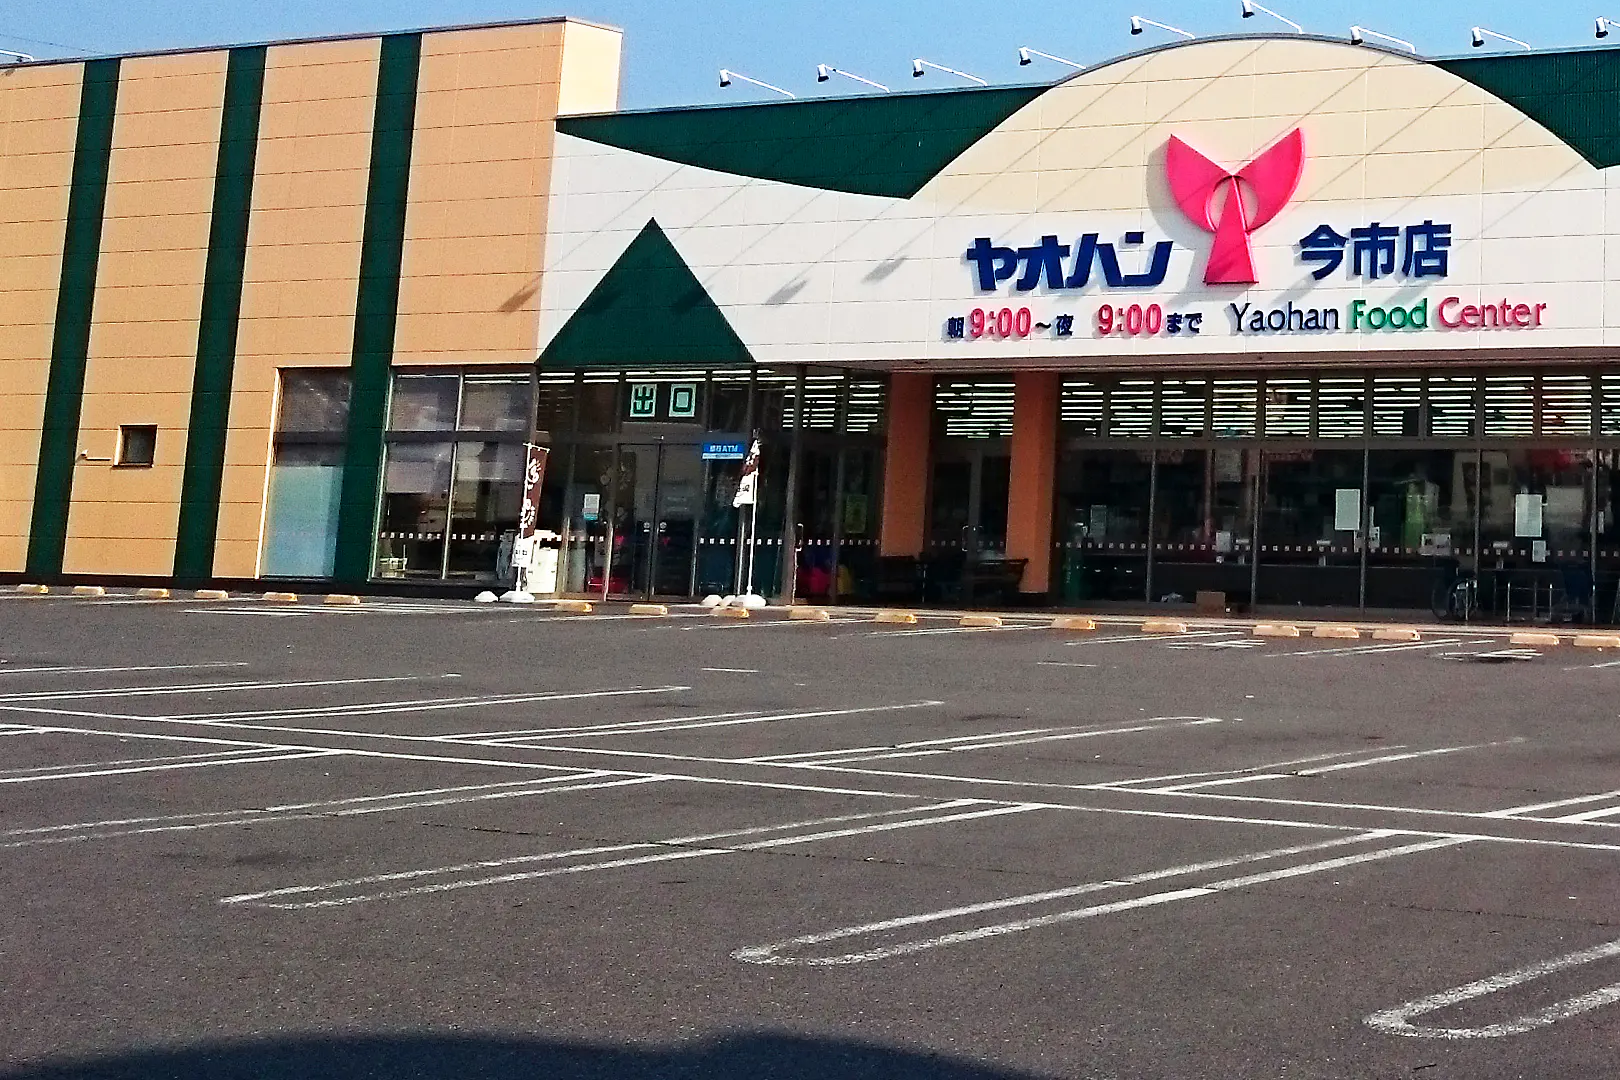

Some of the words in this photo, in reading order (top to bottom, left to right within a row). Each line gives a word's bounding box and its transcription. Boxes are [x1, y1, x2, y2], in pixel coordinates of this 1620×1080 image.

[967, 231, 1174, 291] ヤオハン
[1299, 220, 1452, 281] 今市店
[1230, 301, 1340, 332] Yaohan
[1352, 298, 1429, 330] Food
[1438, 297, 1547, 328] Center
[632, 385, 694, 415] 出口
